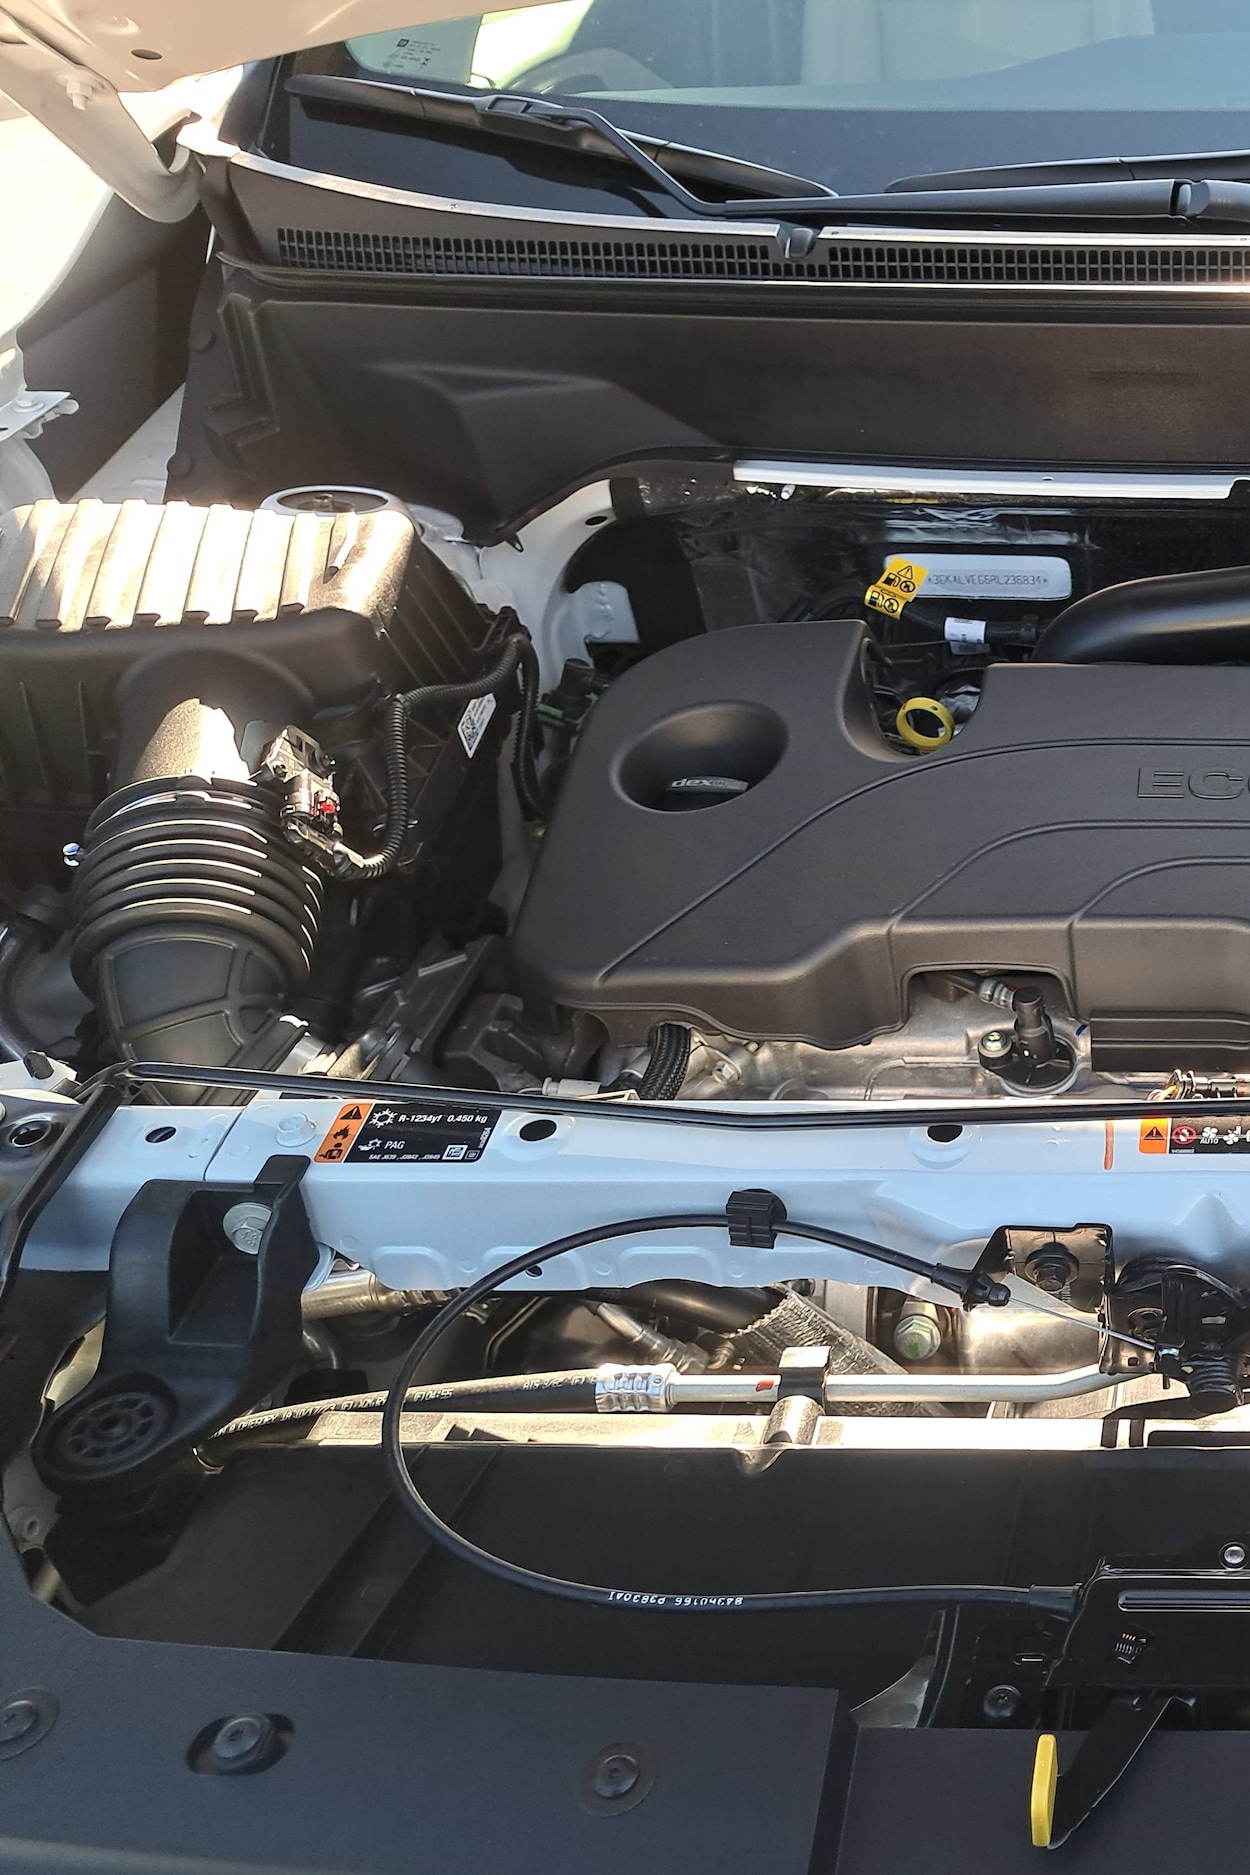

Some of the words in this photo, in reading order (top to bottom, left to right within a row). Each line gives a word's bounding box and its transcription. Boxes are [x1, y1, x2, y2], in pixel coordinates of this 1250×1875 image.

[398, 1114, 442, 1124] R-1234yf
[447, 1115, 473, 1123] 0.450
[475, 1115, 488, 1124] kg
[384, 1141, 405, 1150] PAG
